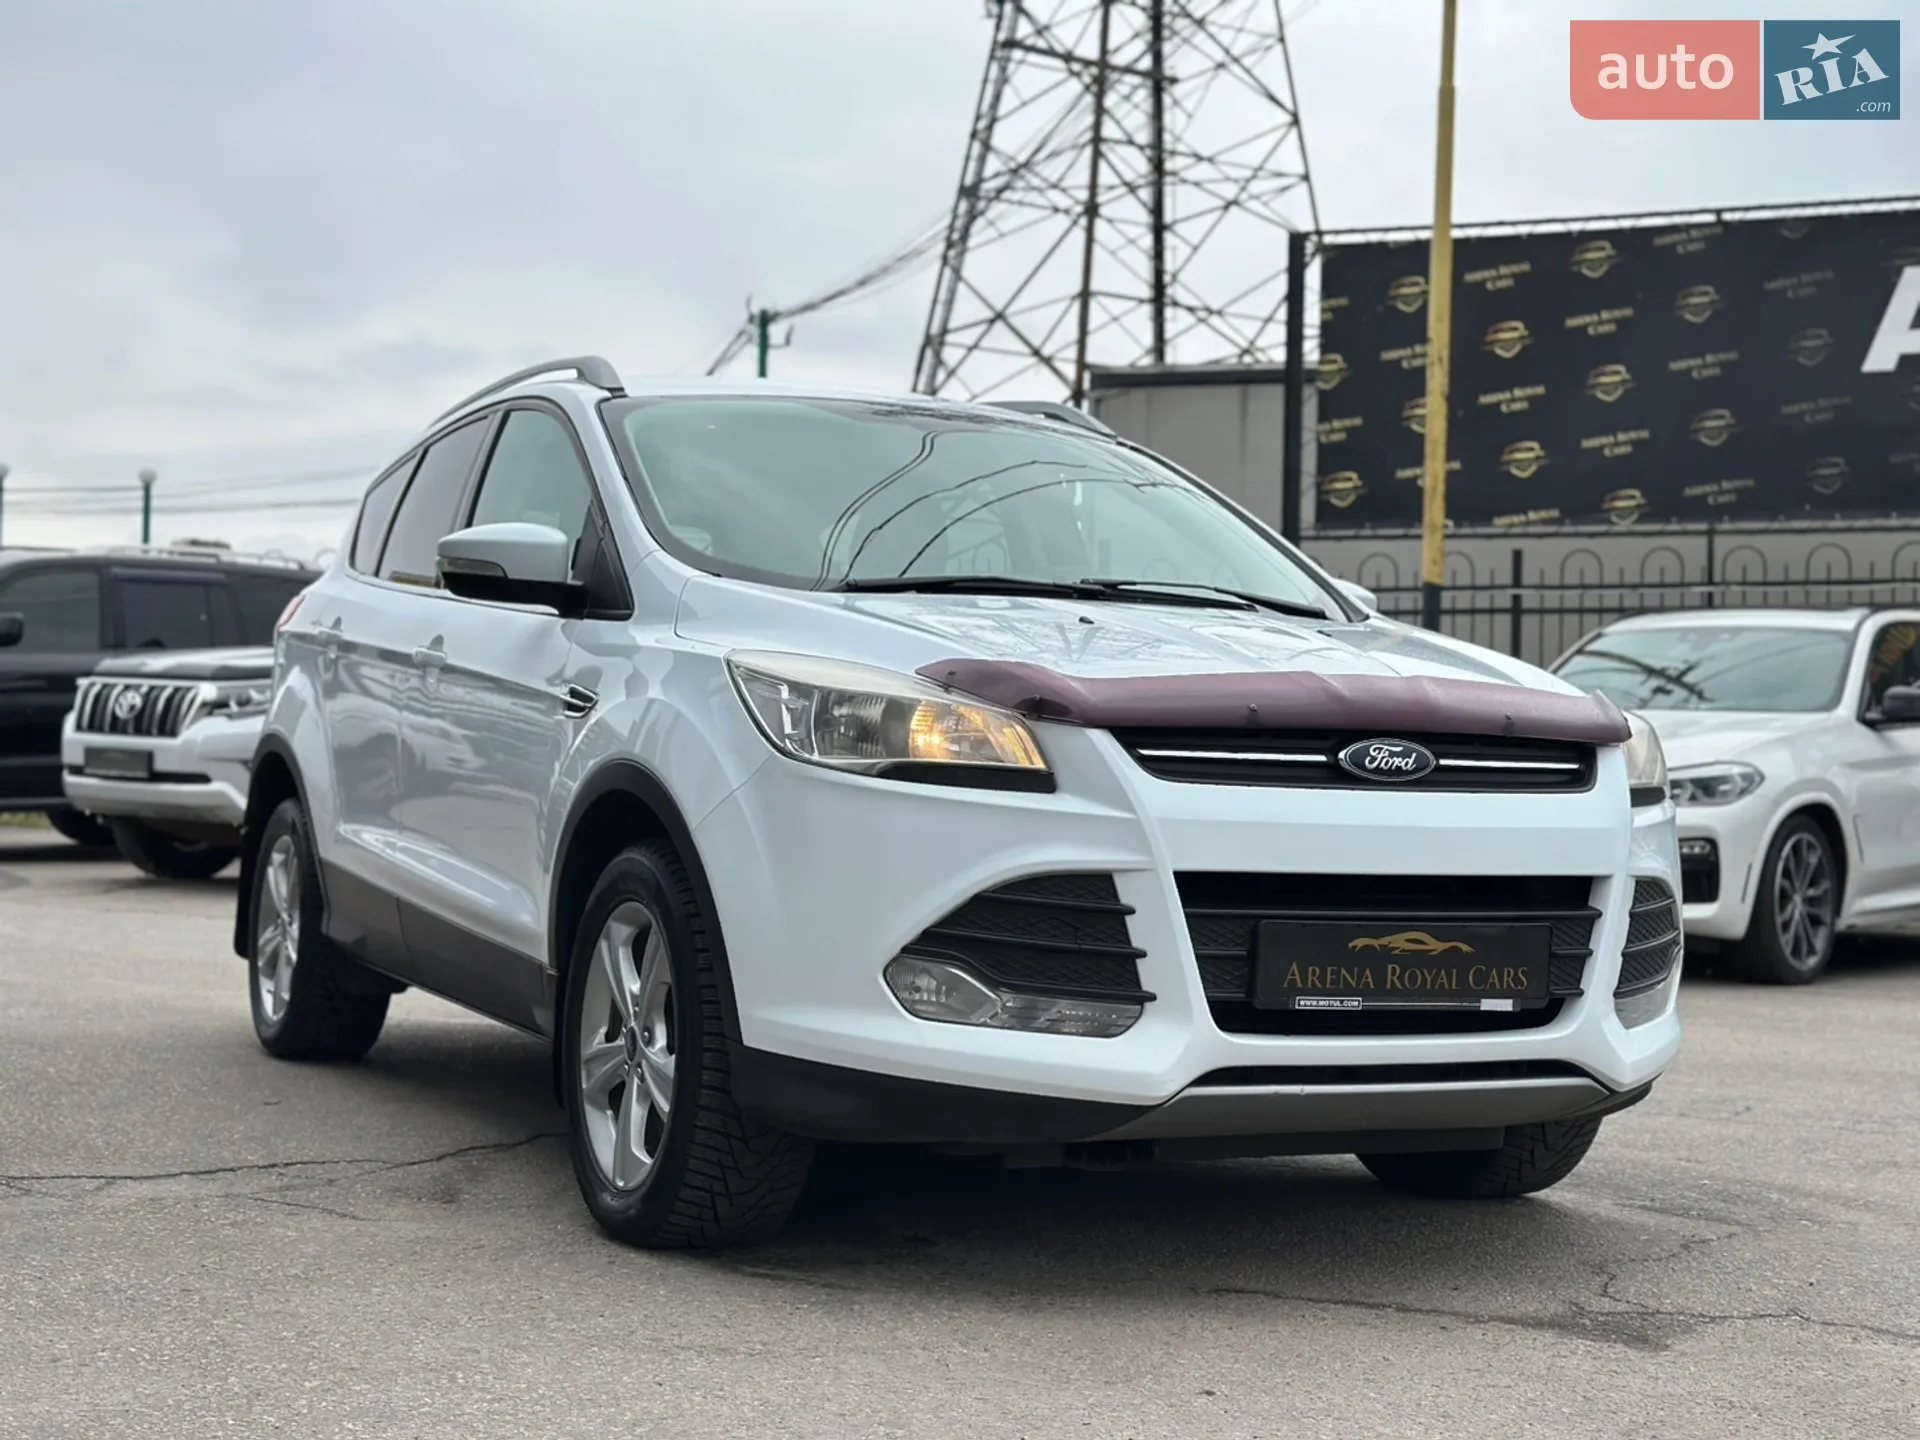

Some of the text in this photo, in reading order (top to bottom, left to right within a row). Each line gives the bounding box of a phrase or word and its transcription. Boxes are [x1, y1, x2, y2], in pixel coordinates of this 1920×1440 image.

[1364, 744, 1417, 771] Ford
[1283, 961, 1529, 990] ARENA ROYAL CARS
[1299, 999, 1359, 1008] WWW.MOTUL.COM
